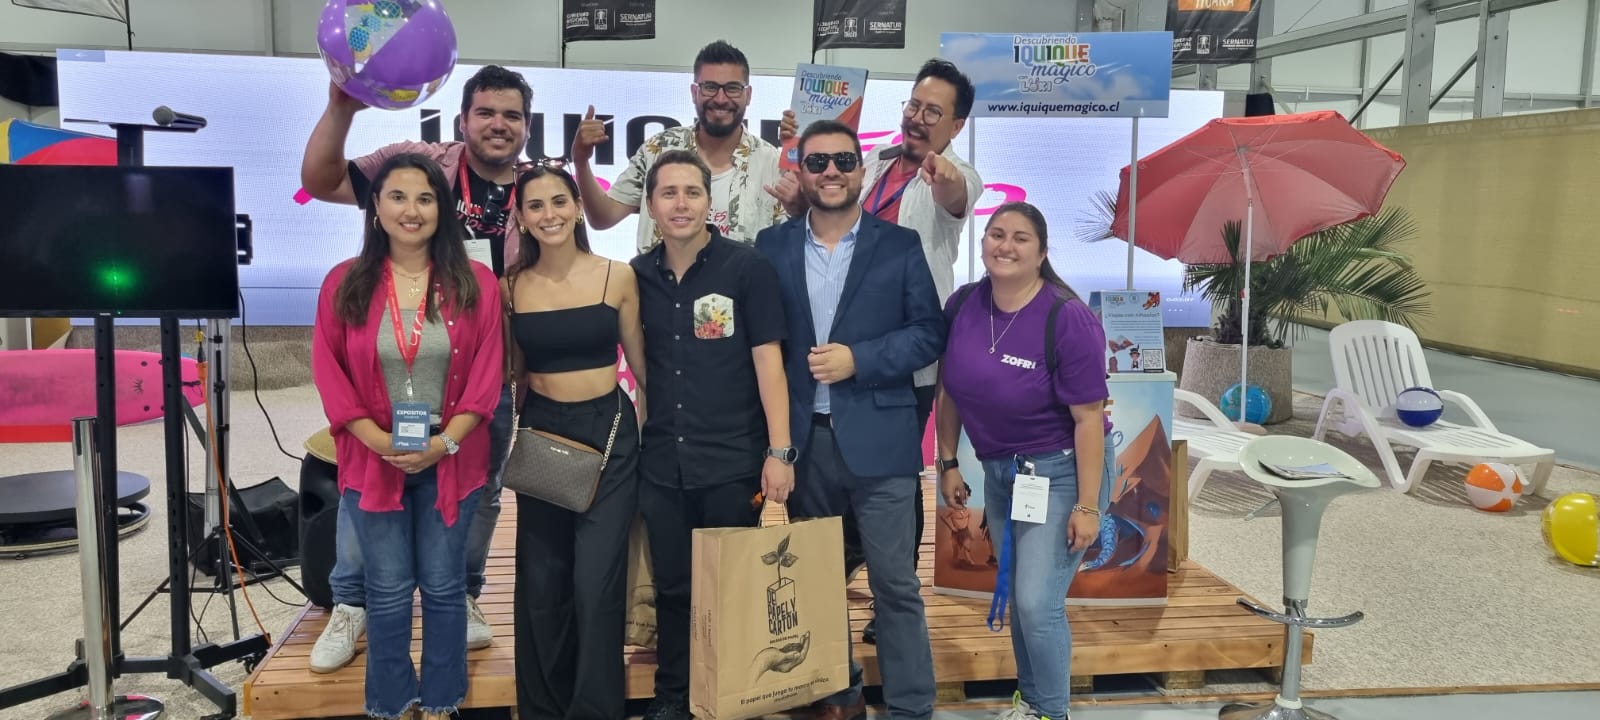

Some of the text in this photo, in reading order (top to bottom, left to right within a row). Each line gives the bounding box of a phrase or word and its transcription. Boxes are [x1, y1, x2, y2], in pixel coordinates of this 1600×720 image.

[619, 13, 652, 21] SERNATUR
[869, 21, 902, 29] SERNATUR
[1014, 35, 1077, 45] Descubriendo
[1222, 38, 1255, 46] SERNATUR
[1014, 44, 1089, 67] IQUIQUE
[801, 70, 842, 80] Descubriendo
[800, 77, 849, 97] IQUIQUE
[988, 101, 1120, 114] www.iquiquemagico.cl
[1001, 354, 1036, 369] ZOFRI
[768, 600, 792, 620] PAPEL
